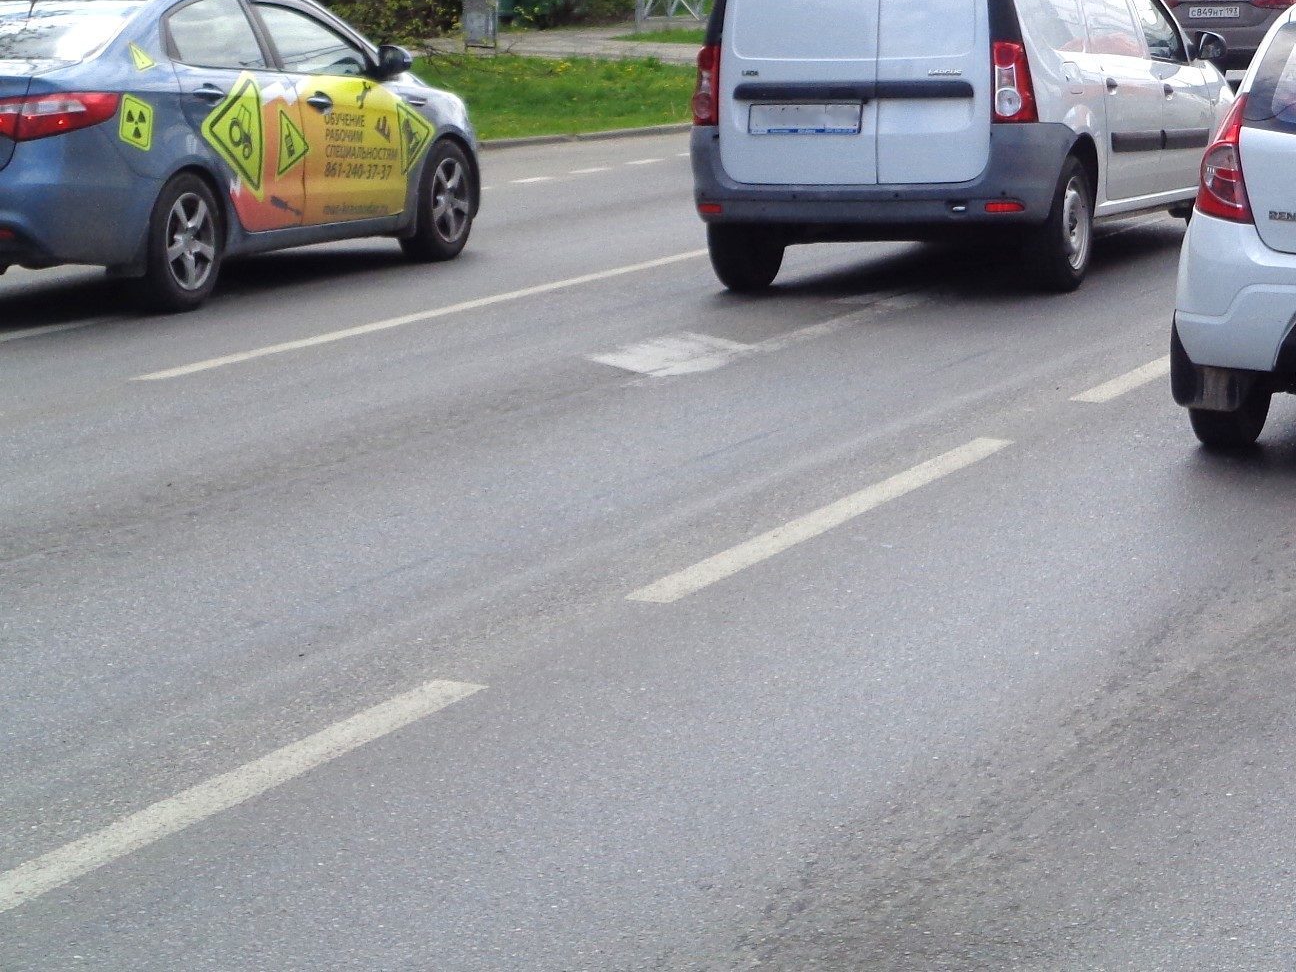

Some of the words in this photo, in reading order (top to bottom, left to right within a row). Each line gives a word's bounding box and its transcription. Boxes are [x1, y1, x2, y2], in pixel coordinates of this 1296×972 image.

[323, 113, 366, 128] ОБУЧЕНИЕ
[325, 129, 364, 144] РАБОЧИМ
[325, 144, 398, 161] СПЕЦИАЛЬНОСТЯМ
